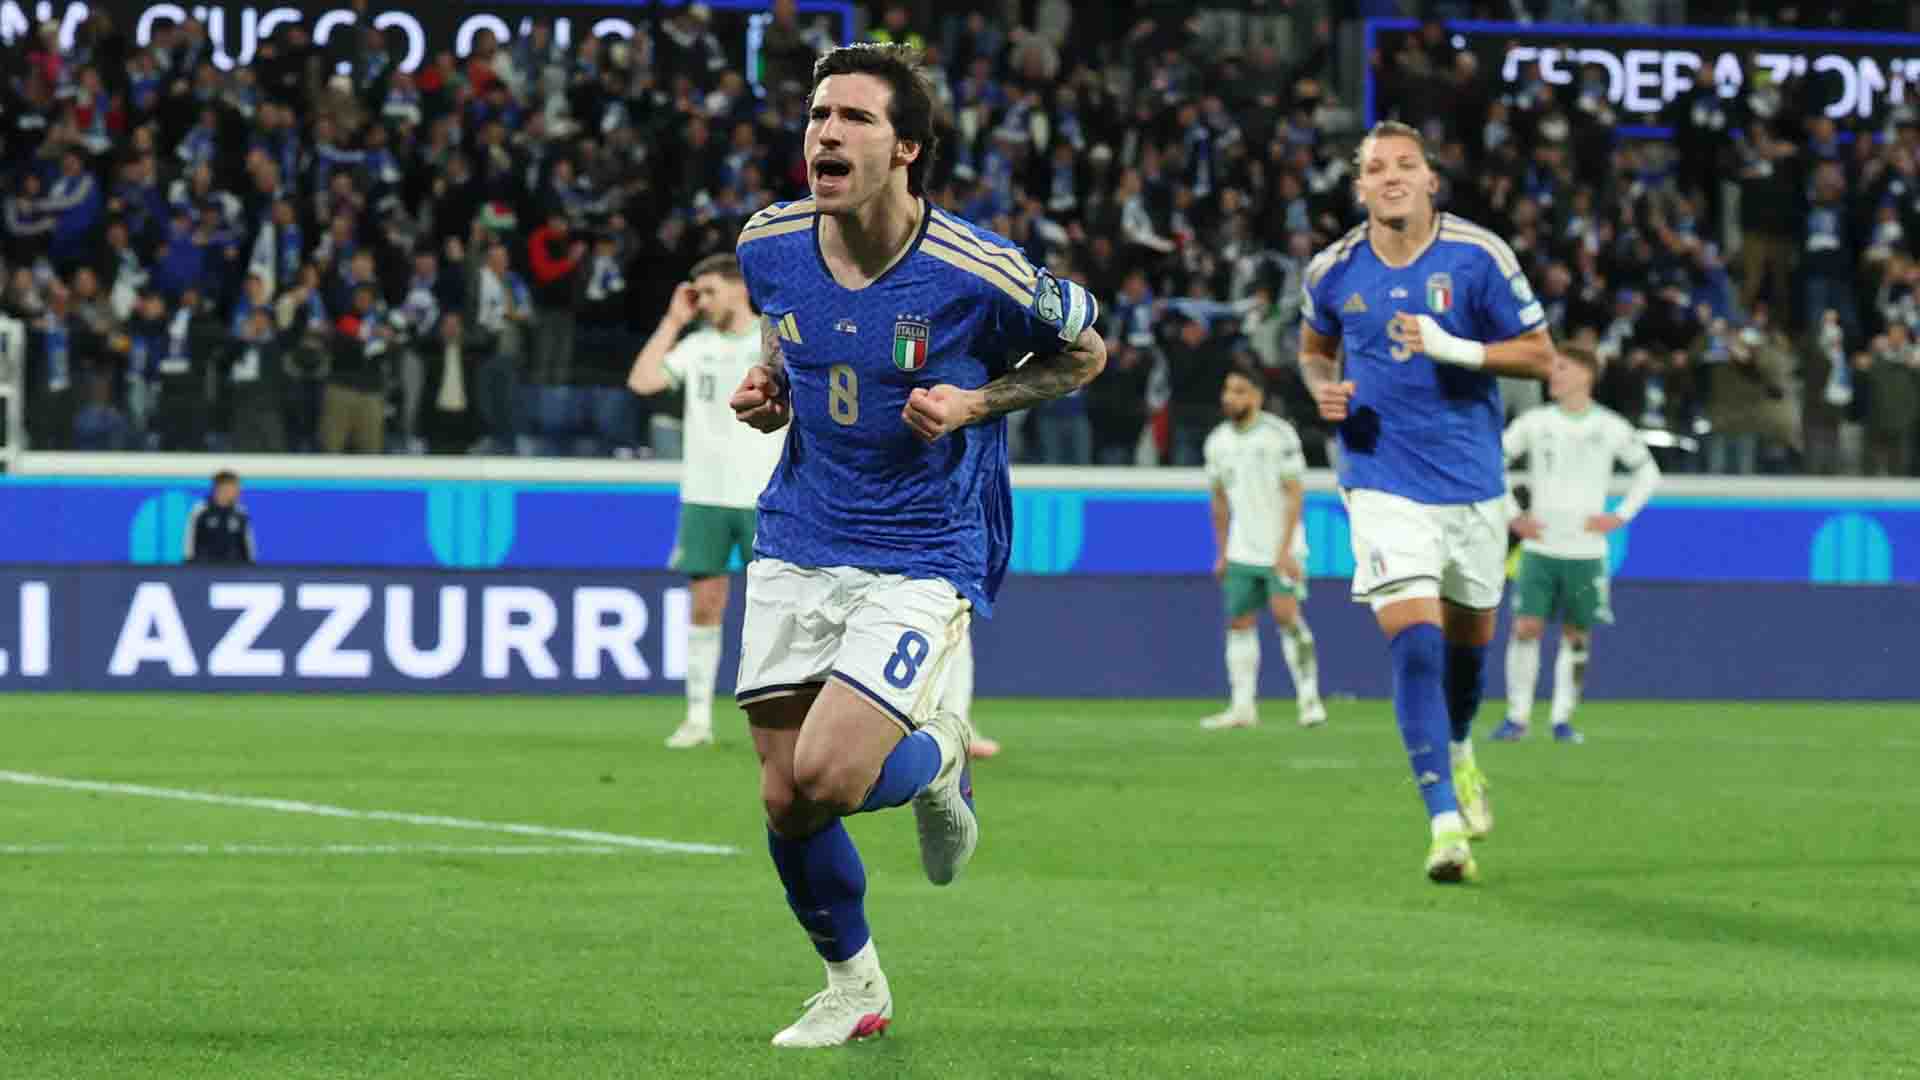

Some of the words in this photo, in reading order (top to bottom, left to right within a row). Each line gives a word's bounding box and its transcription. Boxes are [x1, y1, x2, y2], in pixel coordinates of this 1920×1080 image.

[896, 325, 926, 338] ITALIA
[828, 365, 859, 425] 8
[0, 583, 50, 676] I
[108, 583, 689, 680] AZZURRI
[883, 630, 930, 689] 8
